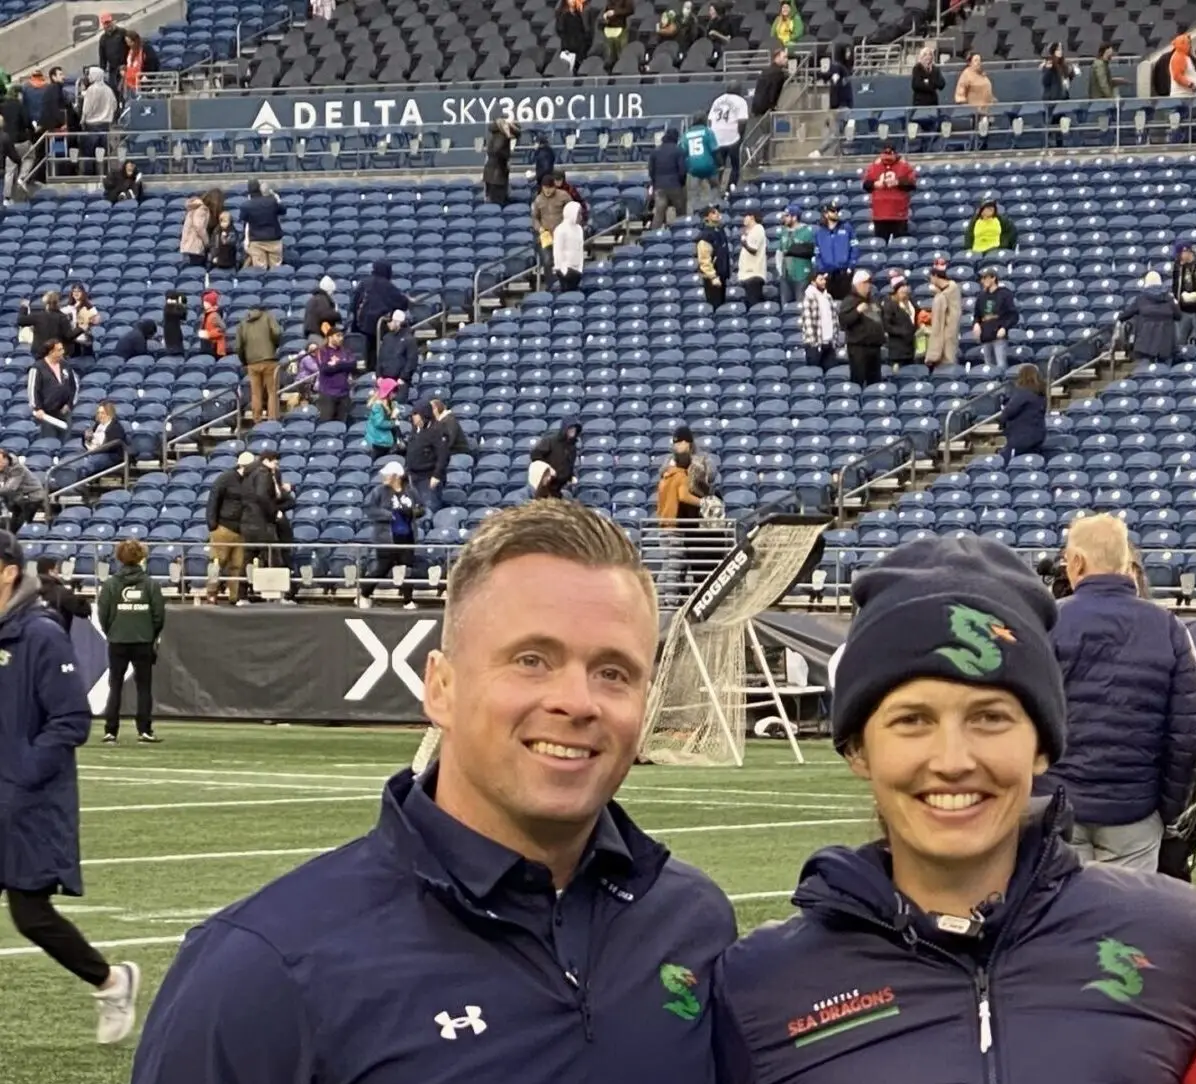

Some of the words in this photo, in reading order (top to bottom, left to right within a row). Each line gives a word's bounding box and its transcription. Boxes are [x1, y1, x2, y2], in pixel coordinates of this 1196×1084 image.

[294, 99, 423, 129] DELTA
[688, 137, 704, 156] 15
[693, 550, 748, 617] ROGERS
[343, 618, 438, 702] X
[787, 1014, 818, 1037] SEA
[819, 986, 896, 1024] DRAGONS
[813, 988, 860, 1012] SEATTLE
